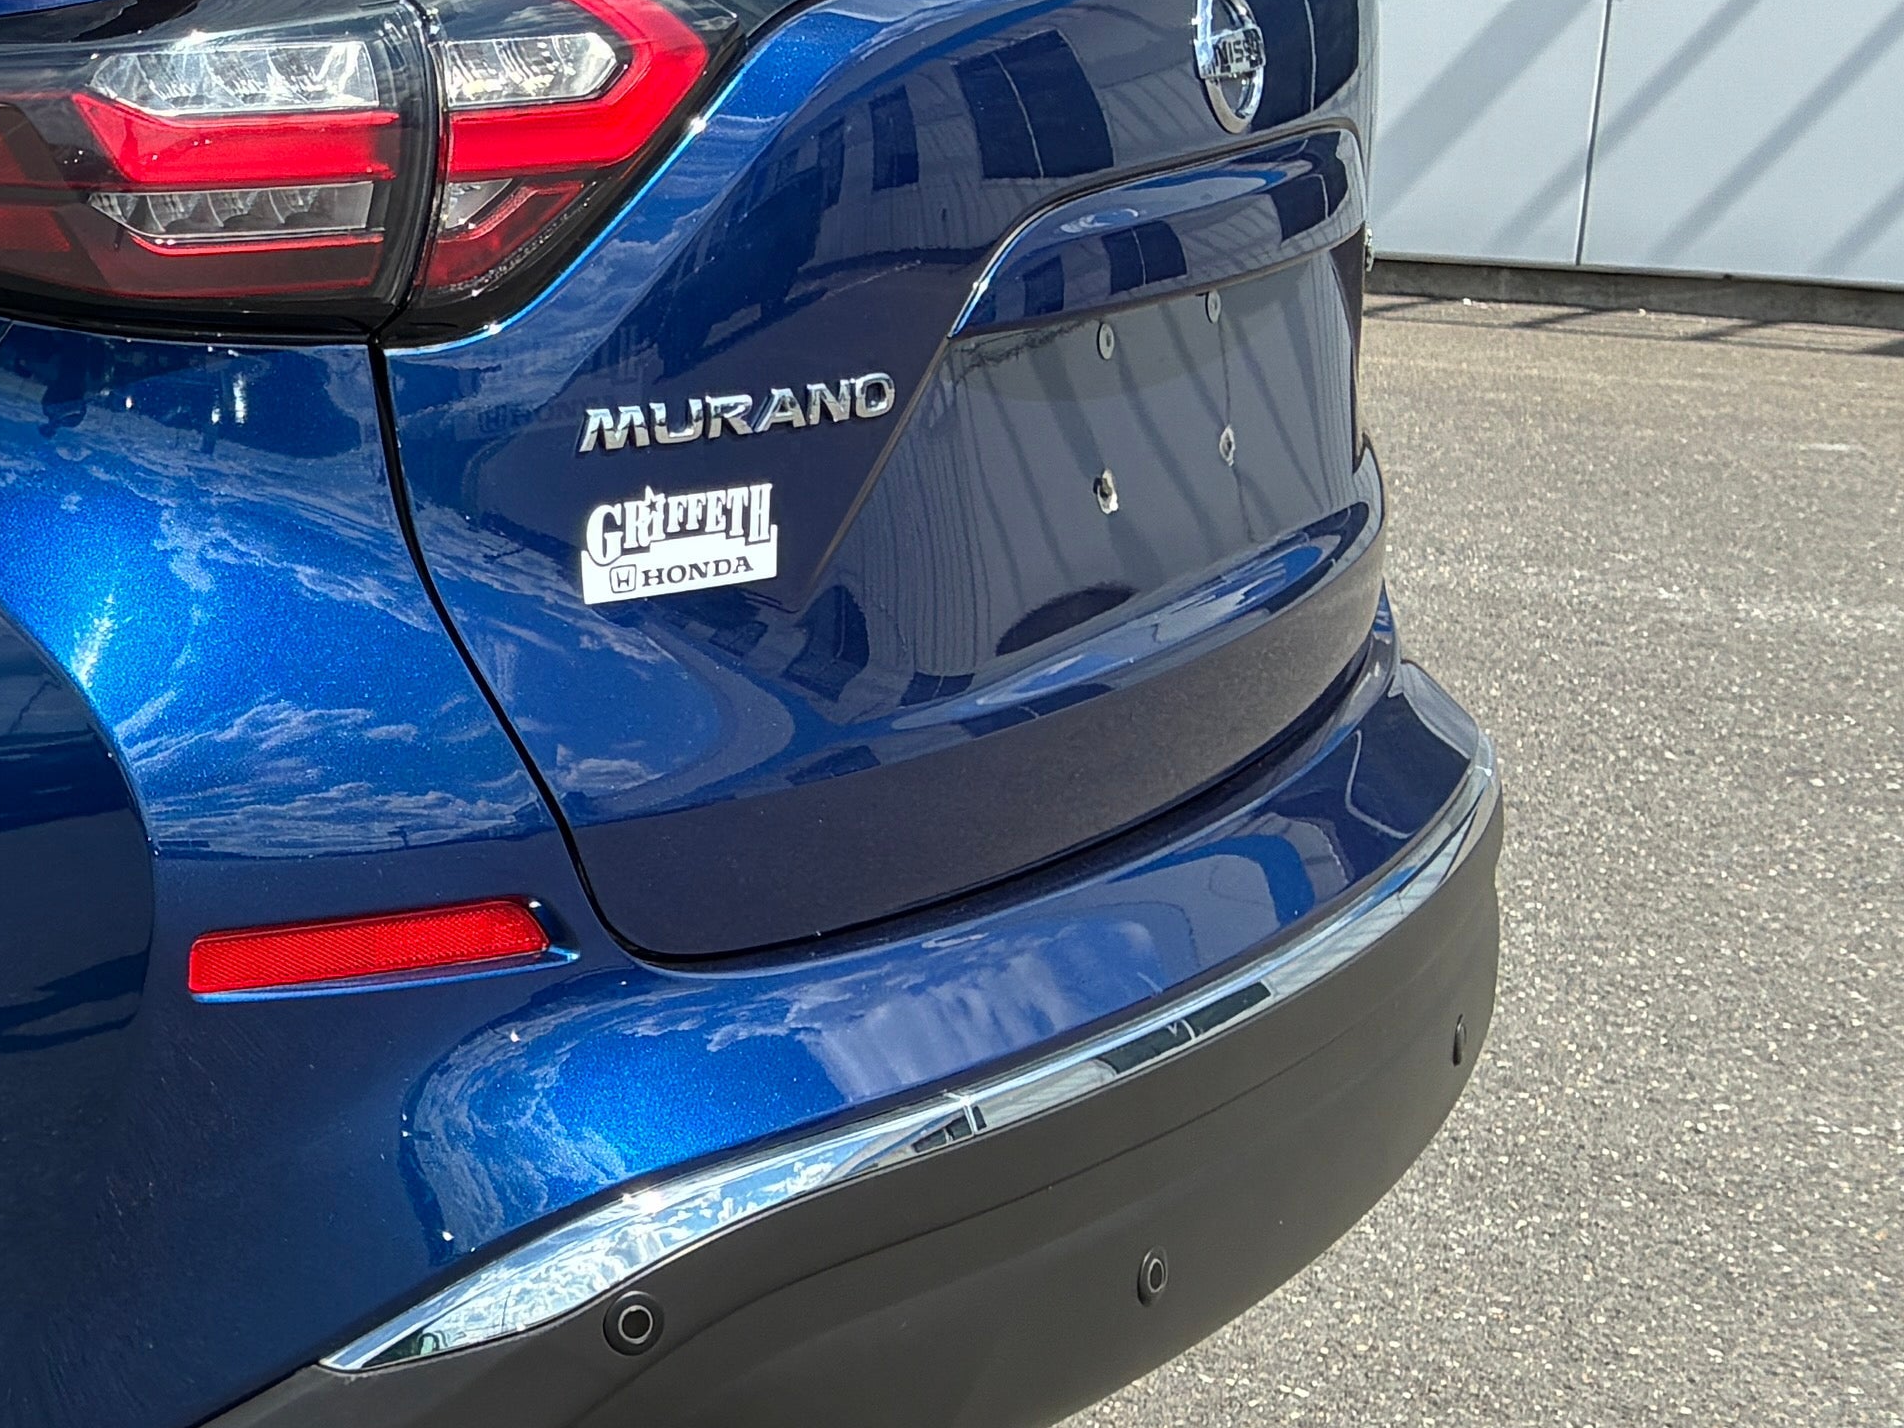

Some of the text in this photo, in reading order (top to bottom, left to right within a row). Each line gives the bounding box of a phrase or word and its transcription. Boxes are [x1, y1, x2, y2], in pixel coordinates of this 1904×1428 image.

[578, 372, 896, 452] MURANO
[587, 483, 773, 566] GRIFFETH
[642, 555, 754, 587] HONDA
